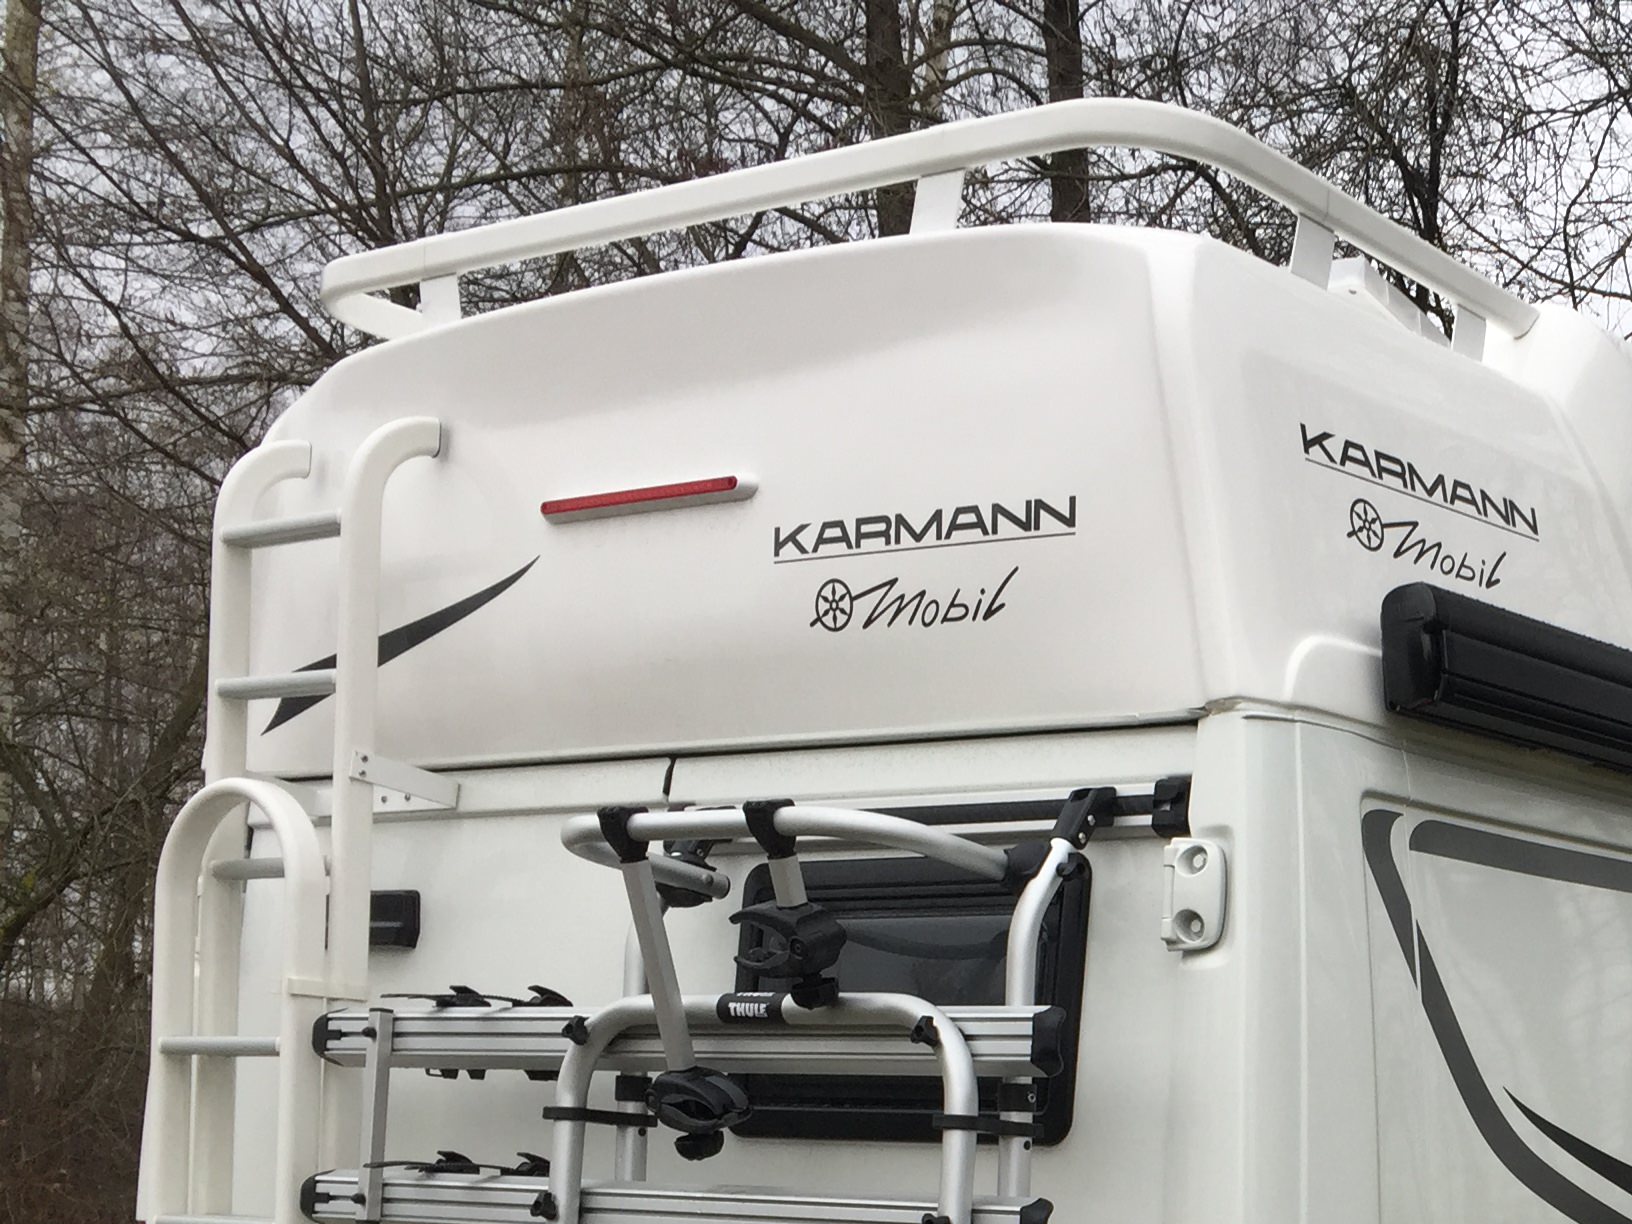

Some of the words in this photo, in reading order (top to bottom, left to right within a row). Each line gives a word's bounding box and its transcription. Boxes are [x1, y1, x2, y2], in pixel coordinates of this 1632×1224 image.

[1299, 422, 1539, 536] KARMANN
[773, 495, 1077, 558] KARMANN
[1382, 521, 1508, 590] Mobil
[851, 566, 1020, 630] Mobil
[727, 1001, 770, 1018] THULE
